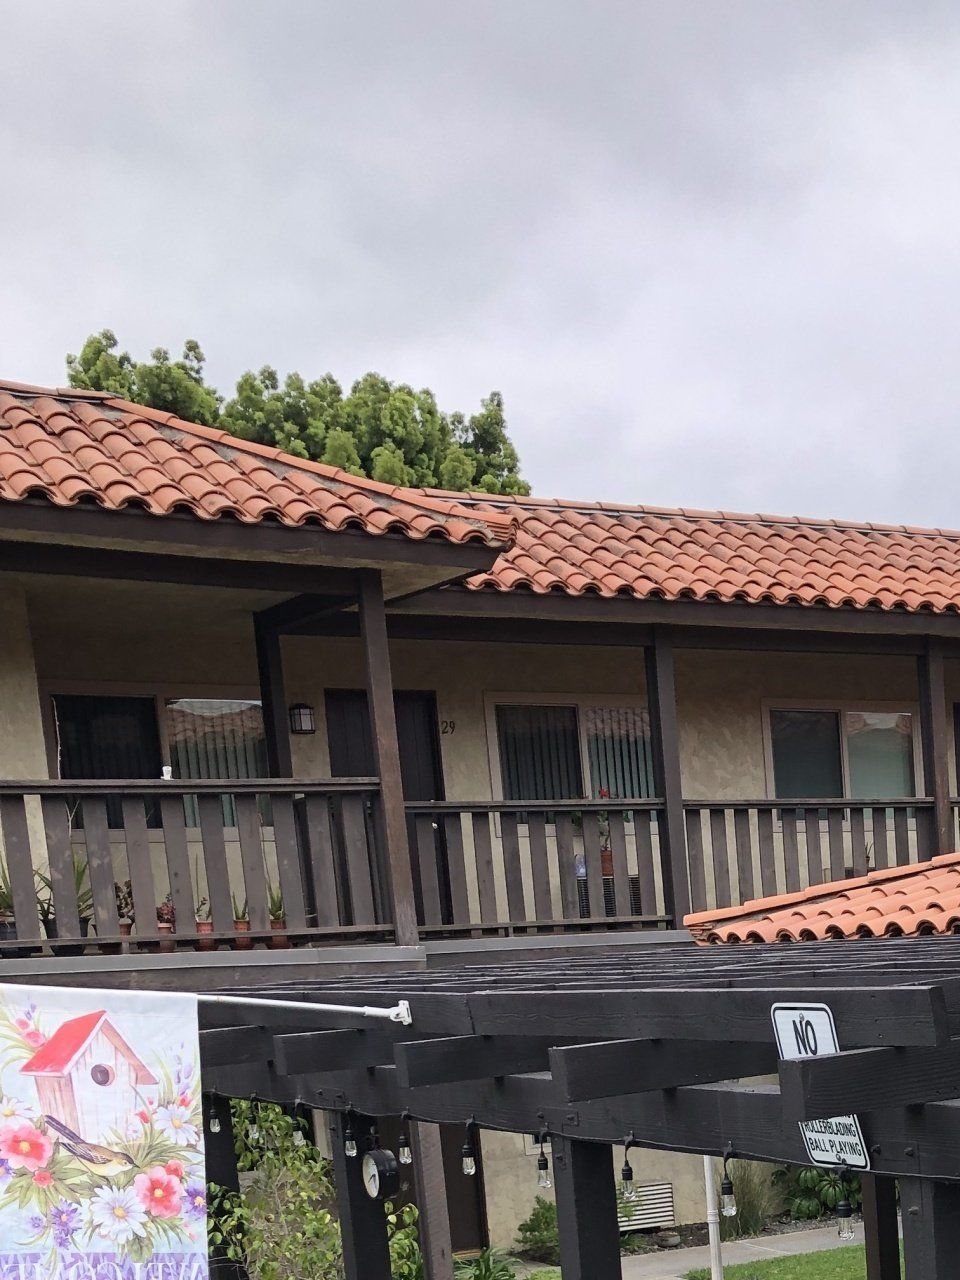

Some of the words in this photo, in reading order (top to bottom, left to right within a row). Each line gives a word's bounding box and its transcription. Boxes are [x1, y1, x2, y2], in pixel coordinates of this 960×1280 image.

[441, 720, 456, 735] 29
[792, 1019, 818, 1056] NO
[804, 1119, 857, 1138] ROLLERBLADING
[808, 1137, 830, 1153] BALL
[829, 1140, 862, 1157] PLAYING
